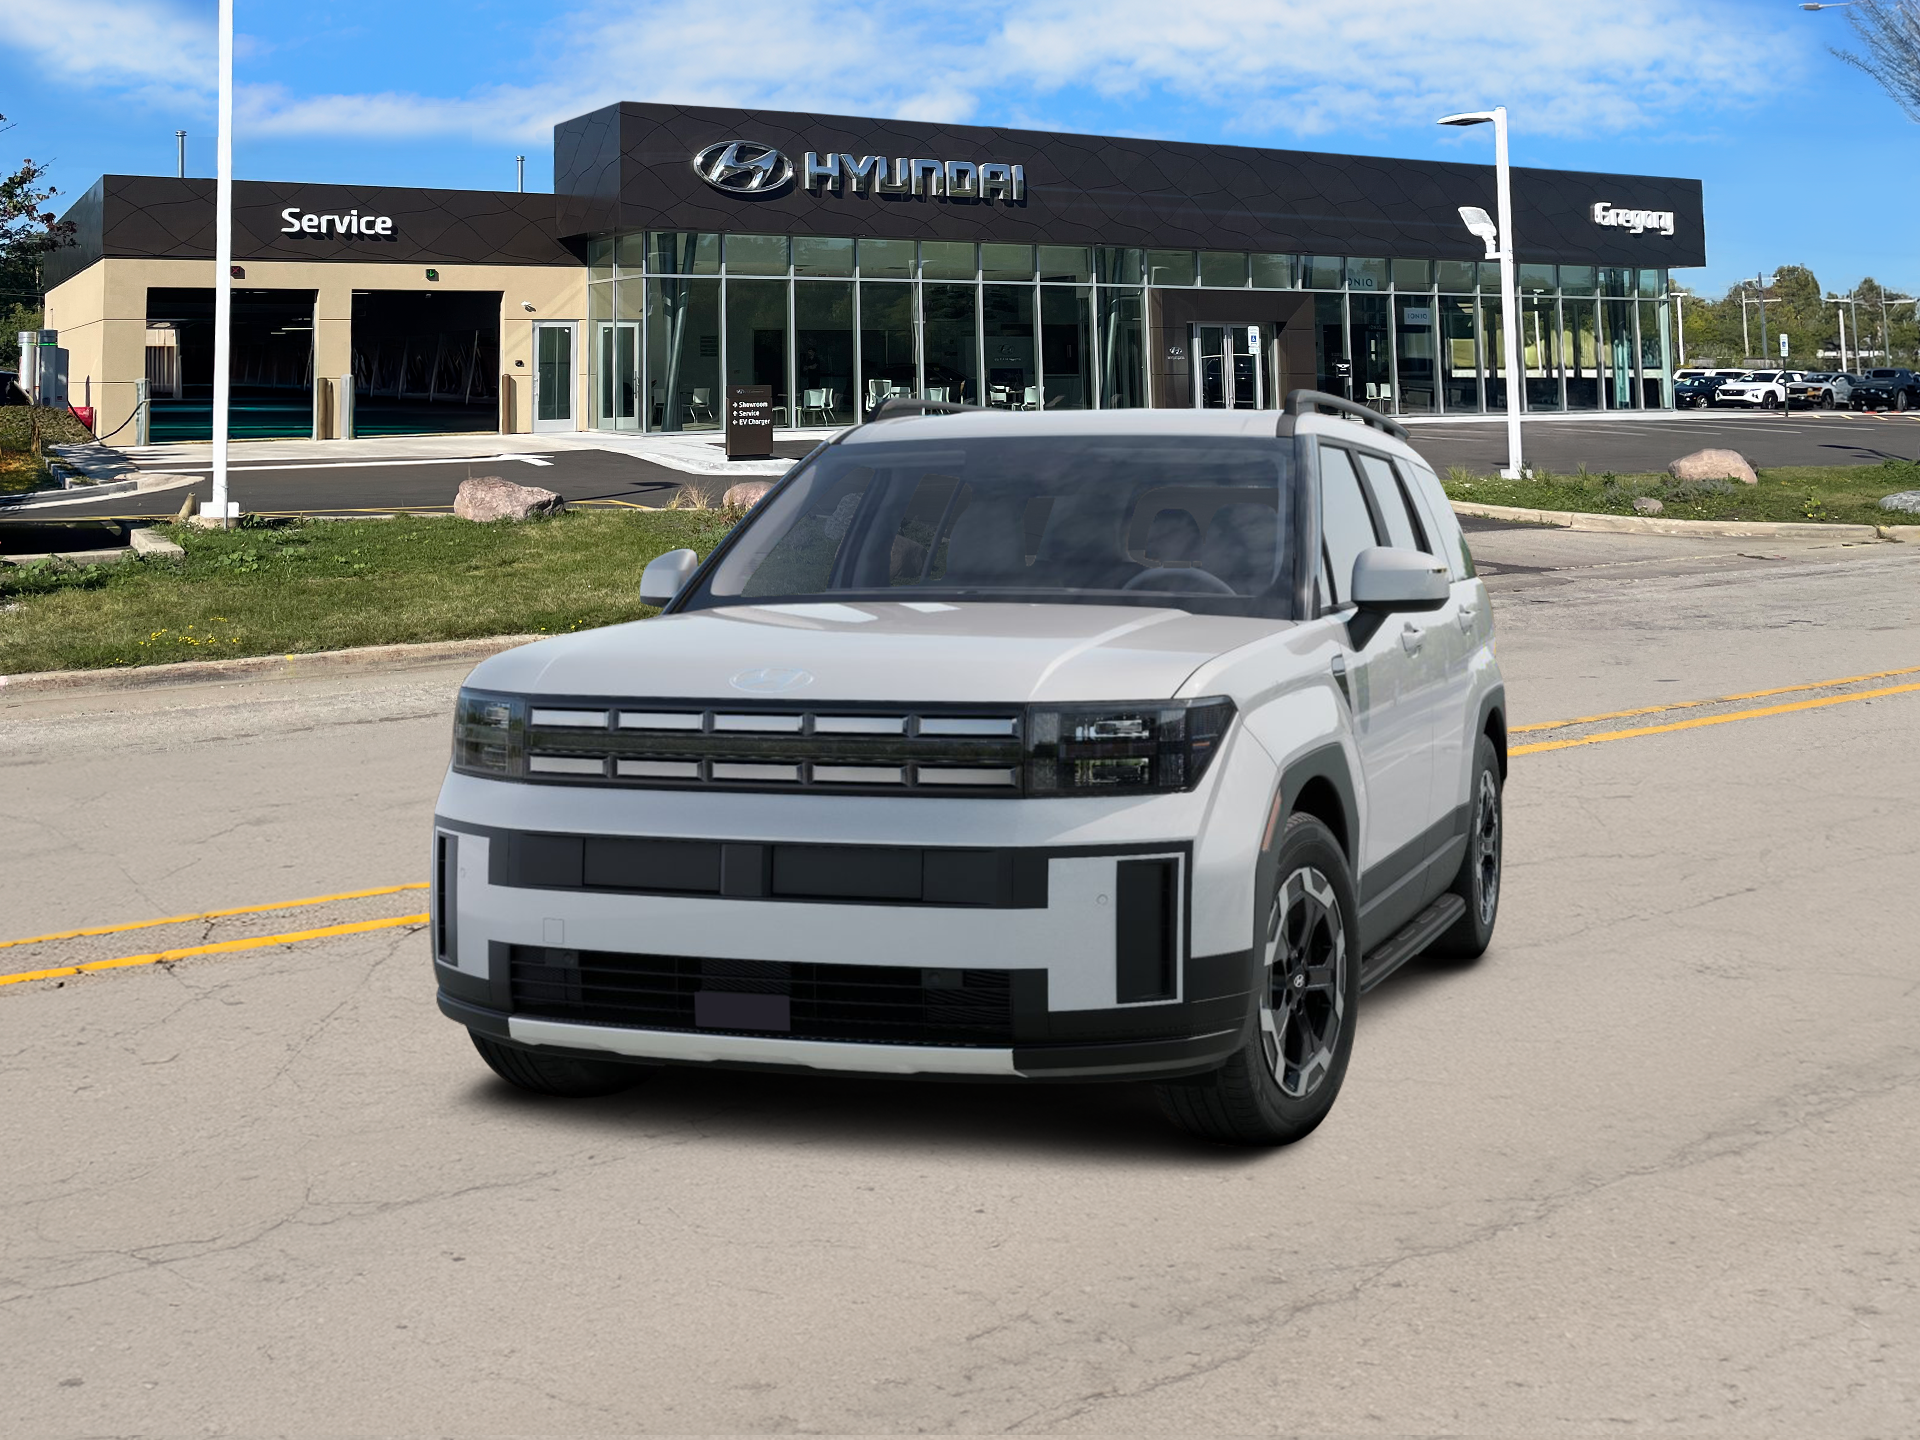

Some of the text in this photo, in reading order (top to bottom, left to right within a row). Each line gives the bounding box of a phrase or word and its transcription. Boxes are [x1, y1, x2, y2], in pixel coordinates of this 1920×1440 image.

[804, 152, 1024, 200] HYUNDAI
[281, 208, 392, 234] Service
[1594, 202, 1674, 235] Gregory
[1347, 278, 1373, 287] ONIQ
[748, 418, 770, 426] Charger
